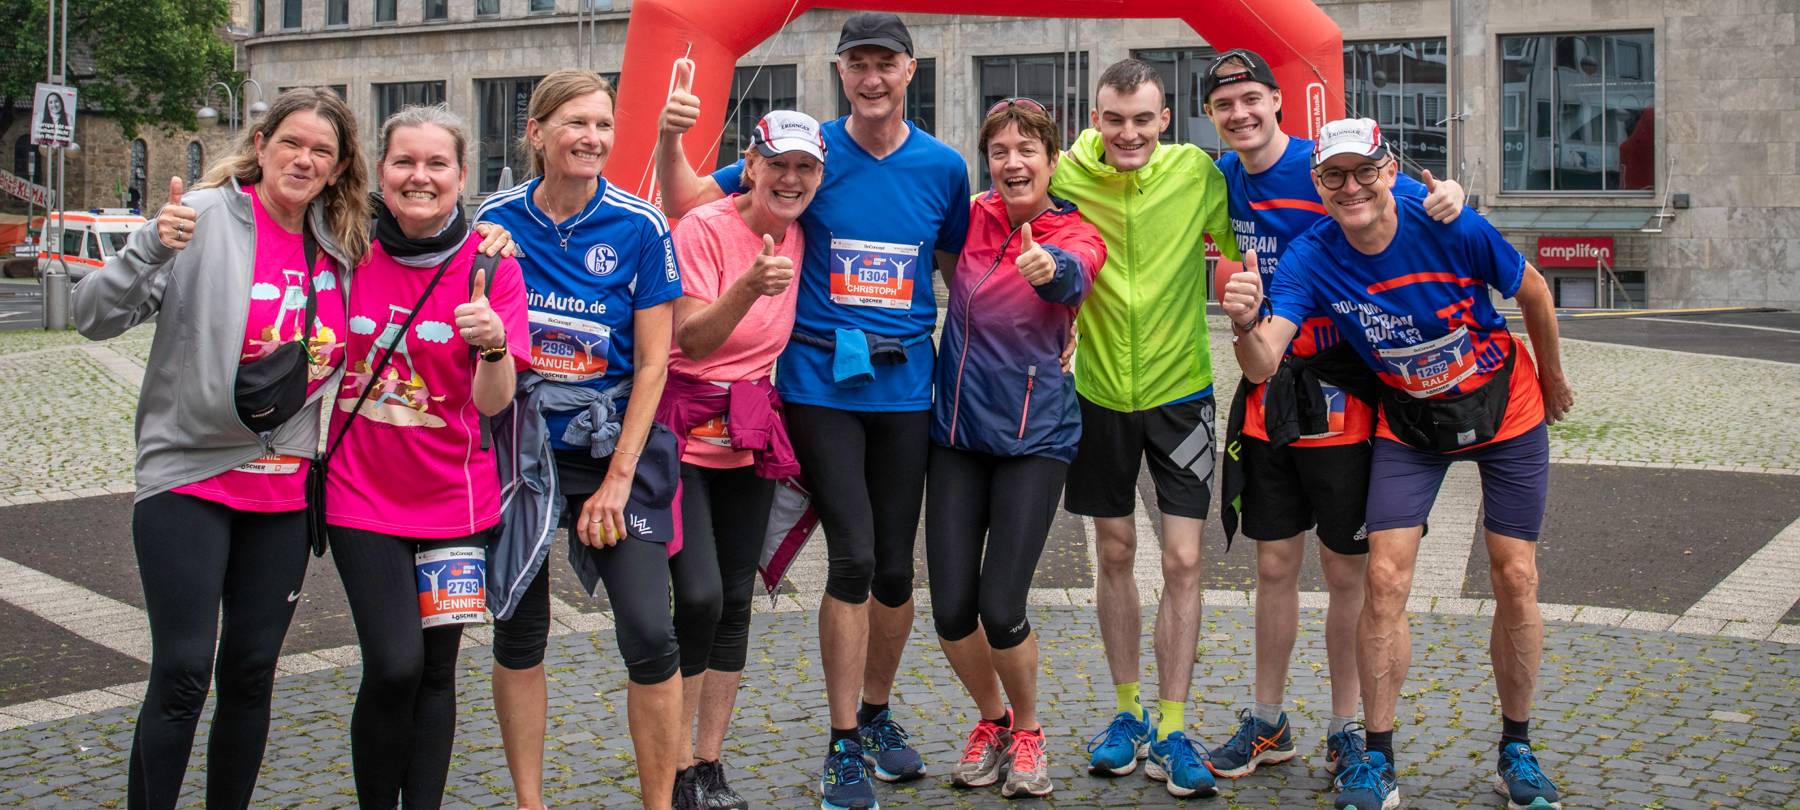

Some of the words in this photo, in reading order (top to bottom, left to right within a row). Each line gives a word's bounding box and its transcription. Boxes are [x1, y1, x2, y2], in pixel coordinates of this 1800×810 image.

[18, 181, 44, 205] KLMA
[1540, 243, 1609, 261] amplifon
[860, 270, 888, 283] 1304
[847, 284, 897, 295] CHRISTOPH
[525, 291, 607, 314] inAuto.de
[542, 342, 574, 356] 2985
[531, 356, 586, 372] MANUELA
[1417, 362, 1448, 378] 1262
[1422, 373, 1450, 388] RALF
[448, 581, 479, 595] 2793
